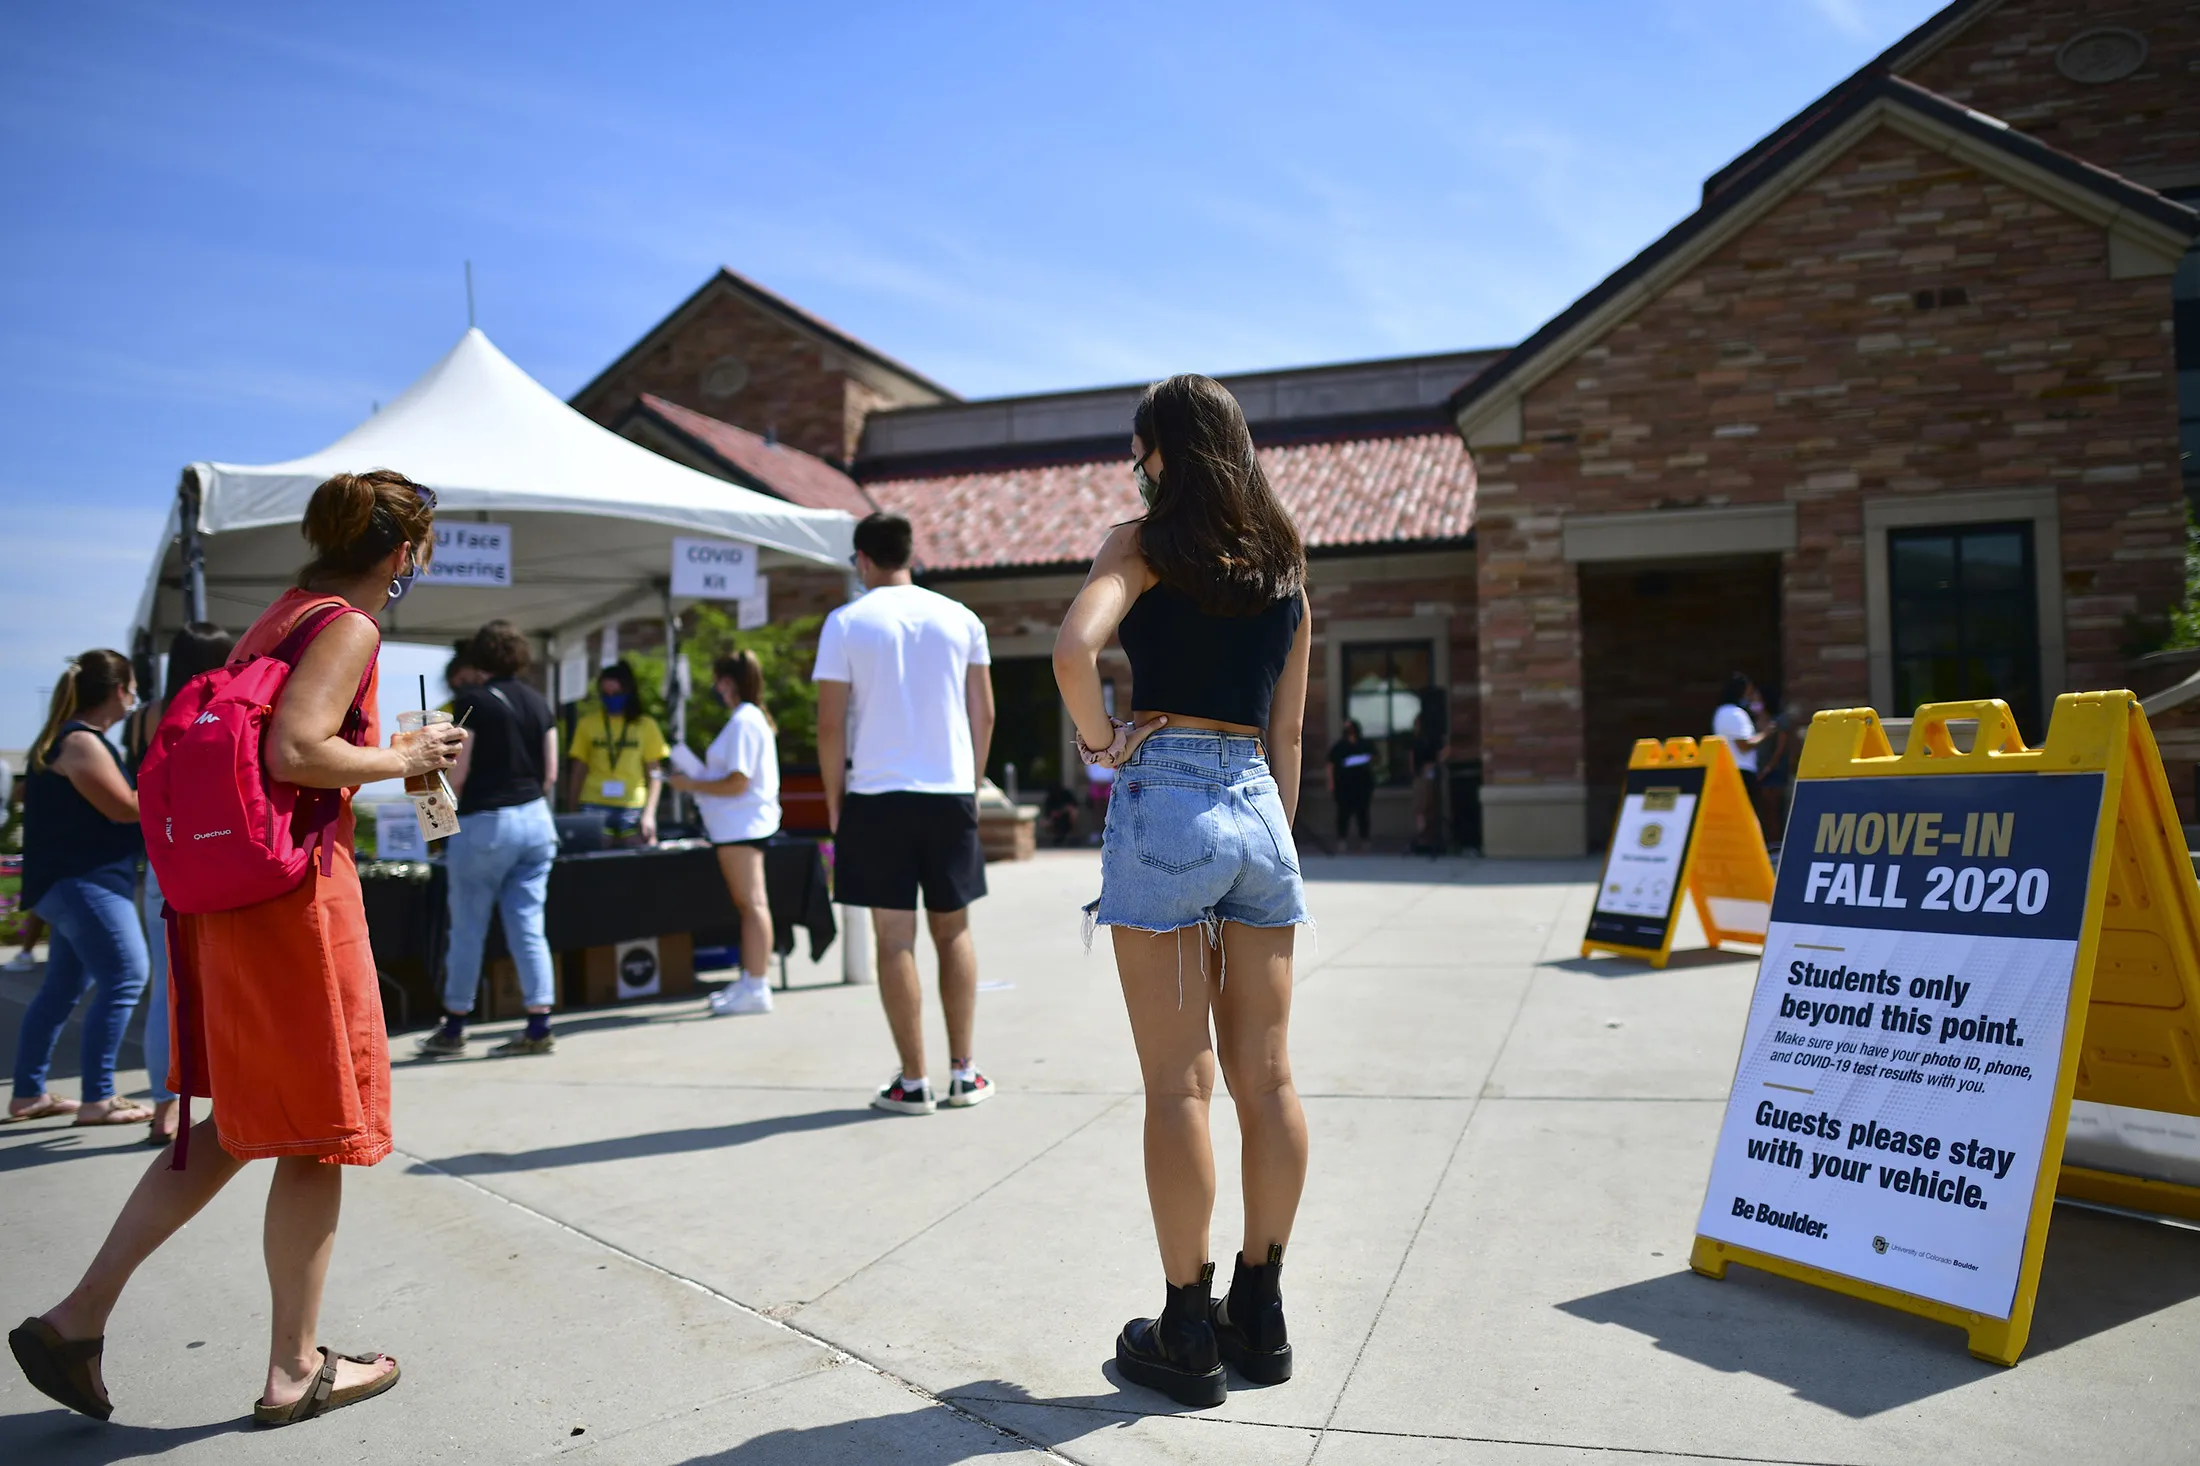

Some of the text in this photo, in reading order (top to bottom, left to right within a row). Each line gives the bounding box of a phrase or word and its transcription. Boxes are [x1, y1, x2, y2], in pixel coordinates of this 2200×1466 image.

[433, 529, 500, 550] U Face
[687, 546, 744, 564] COVID
[431, 559, 506, 583] overing
[703, 573, 728, 590] Kit
[193, 828, 232, 841] Quechua
[1814, 812, 2015, 858] MOVE-IN
[1804, 862, 2050, 916] FALL 2020
[1788, 960, 1971, 1008] Students only
[1780, 993, 2024, 1047] beyond this point.
[1770, 1049, 1986, 1094] and COVID-19 test results with you.
[1774, 1030, 2033, 1081] Make sure you have your photo ID, phone,
[1755, 1100, 2016, 1180] Guests please stay
[1748, 1137, 1988, 1211] with your vehicle.
[1731, 1196, 1829, 1240] Be Boulder.
[1891, 1243, 1979, 1272] University of Colorado Boulder
